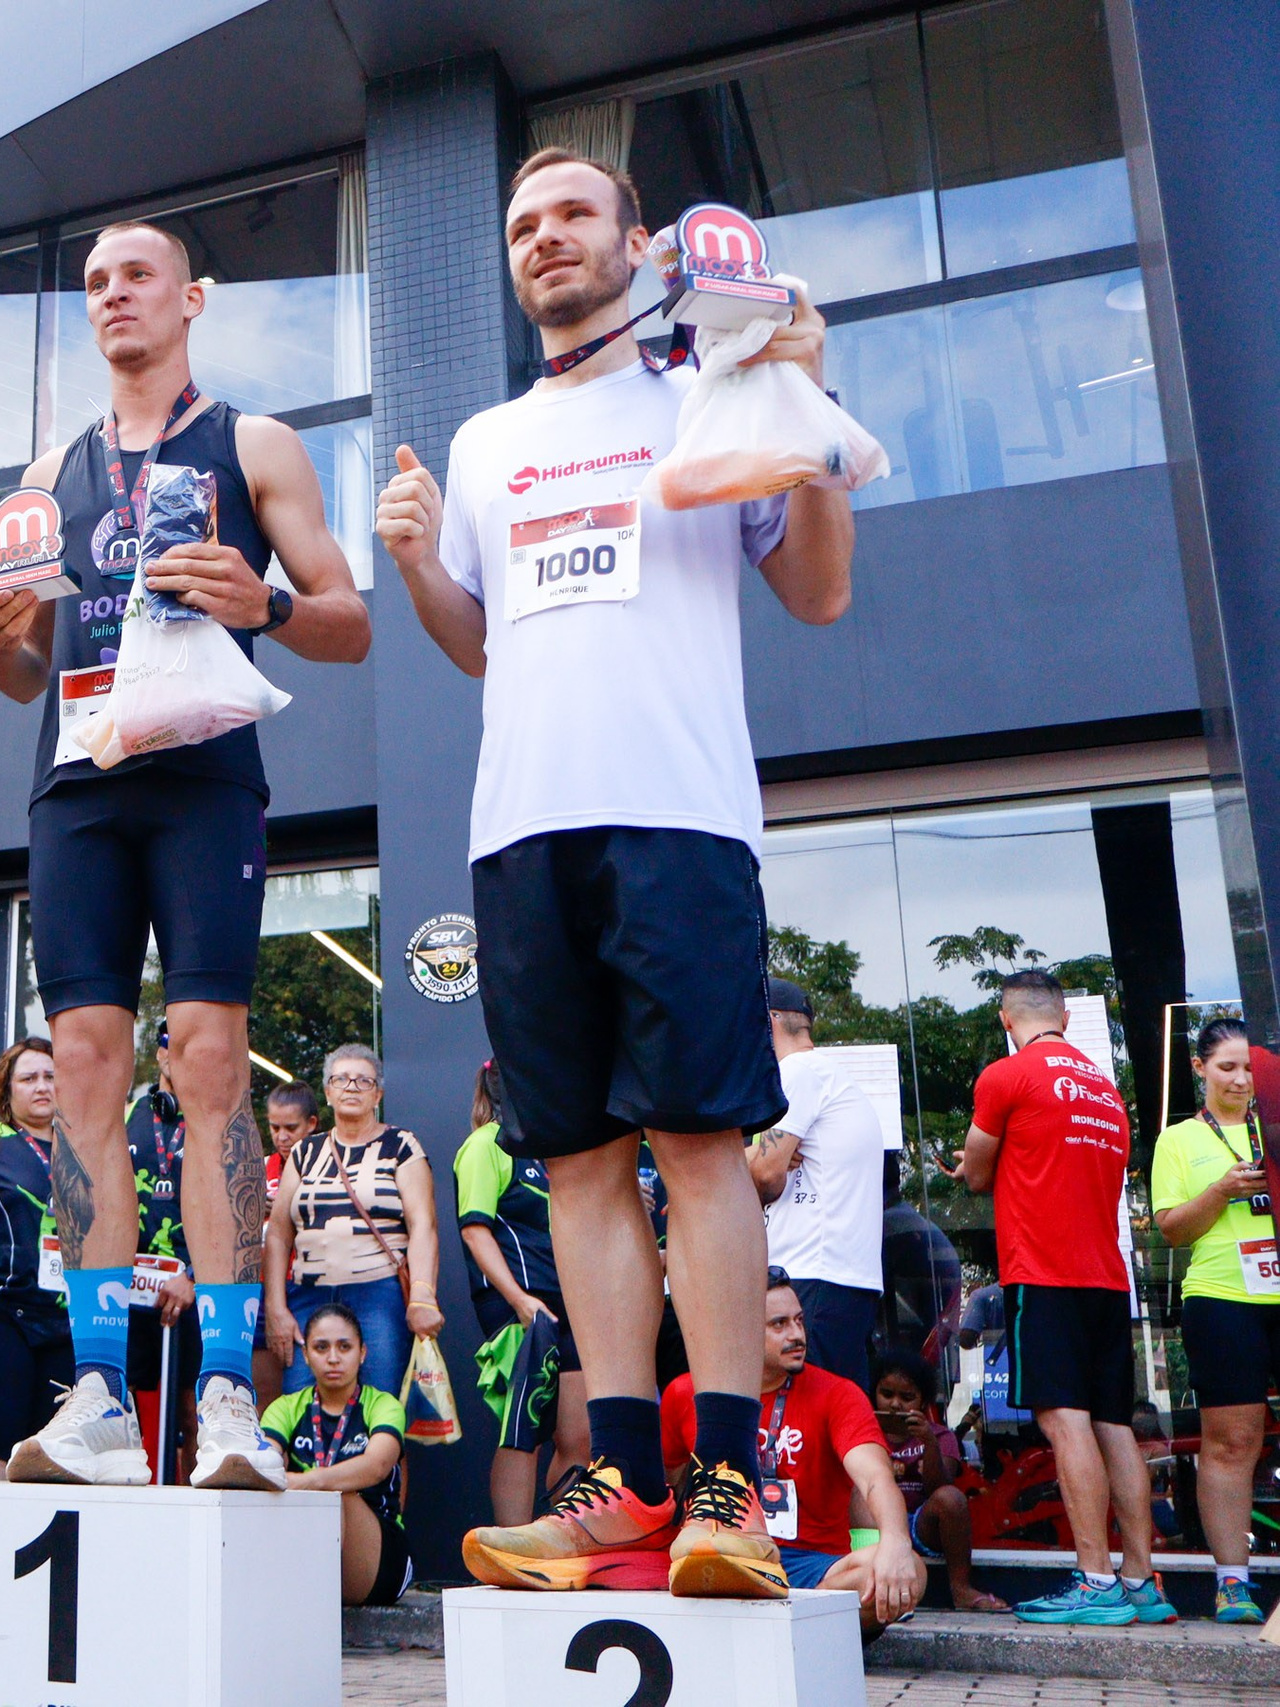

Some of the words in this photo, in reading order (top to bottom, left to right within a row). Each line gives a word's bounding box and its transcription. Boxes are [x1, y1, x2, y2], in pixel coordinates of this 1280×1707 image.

[542, 446, 653, 481] Hidraumak
[617, 528, 636, 541] 10K
[535, 544, 616, 588] 1000
[549, 585, 589, 598] HENRIQUE
[90, 623, 116, 640] Julio
[407, 918, 438, 951] PRONTO
[427, 929, 468, 944] SBV
[442, 963, 459, 973] 24
[408, 974, 424, 993] MAIS
[423, 988, 453, 1003] RÁPIDO
[454, 992, 467, 1001] DA
[14, 1510, 80, 1684] 1
